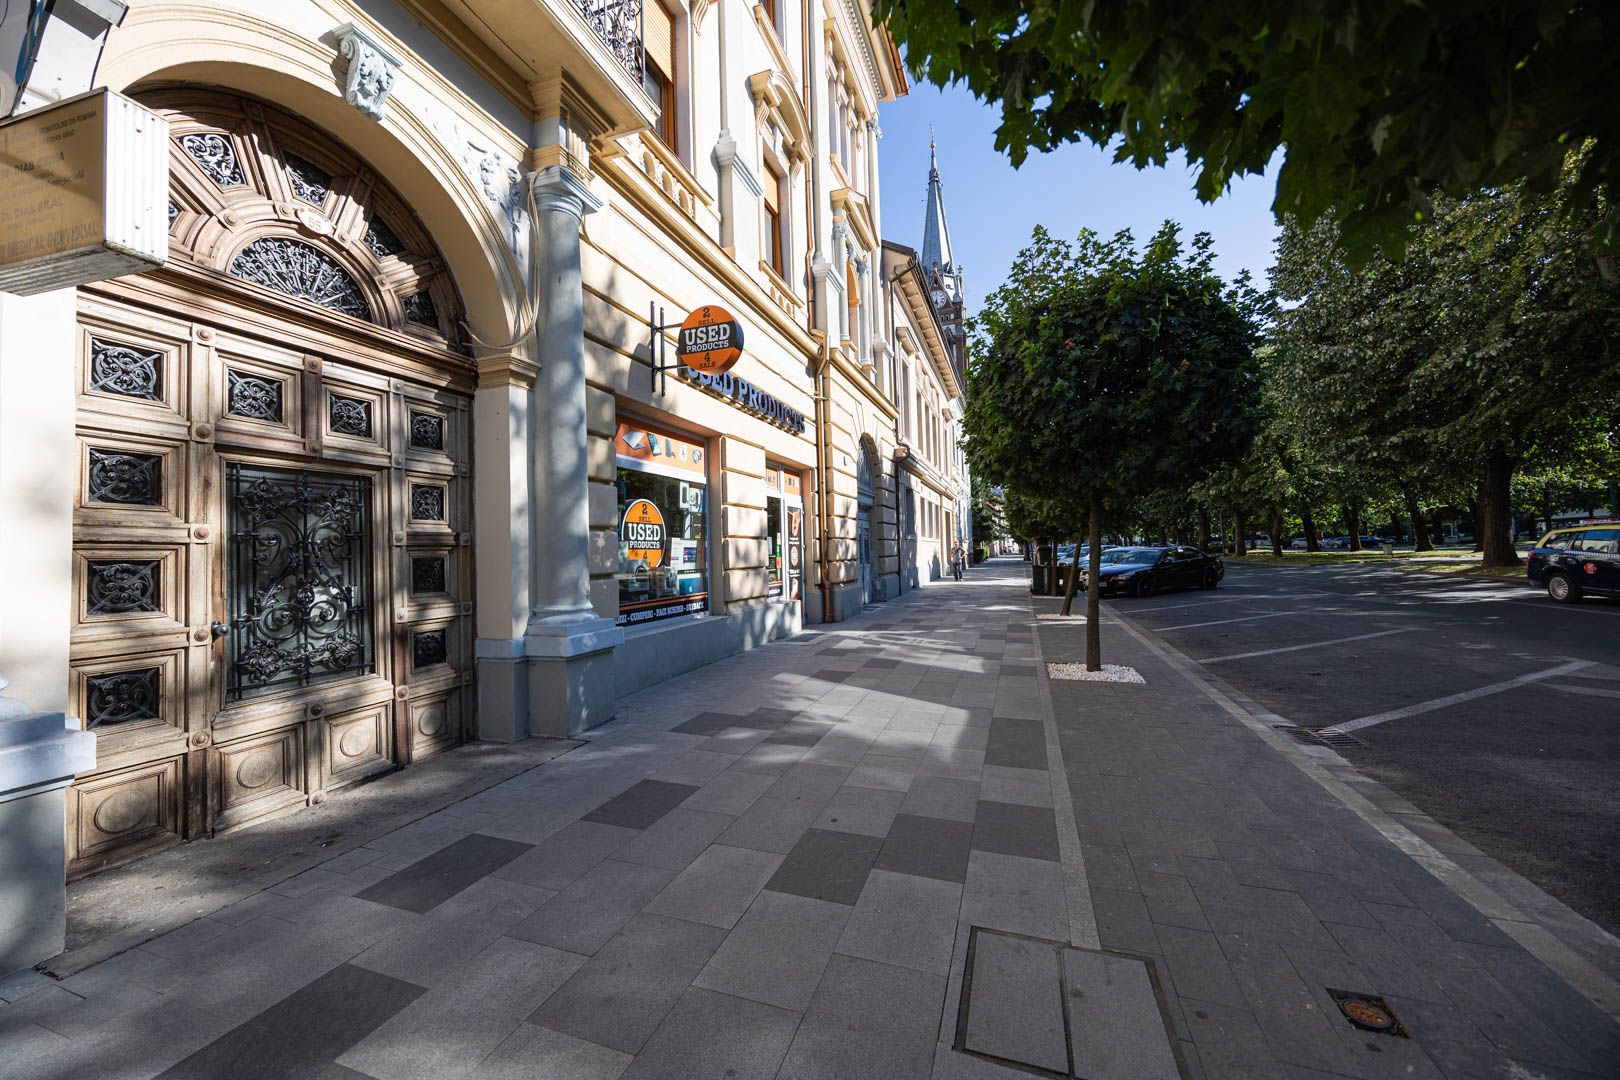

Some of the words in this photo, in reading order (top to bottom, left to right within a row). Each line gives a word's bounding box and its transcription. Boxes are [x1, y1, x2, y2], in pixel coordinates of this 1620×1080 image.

[703, 307, 711, 318] 2
[698, 318, 716, 326] SELL
[685, 324, 730, 345] USED
[686, 340, 729, 353] PRODUCTS
[704, 351, 711, 362] 4
[698, 361, 717, 369] SALE
[738, 377, 805, 432] PRODUCTS
[642, 504, 647, 515] 2
[628, 523, 661, 541] USED
[629, 540, 661, 549] PRODUCTS
[642, 551, 648, 559] 4
